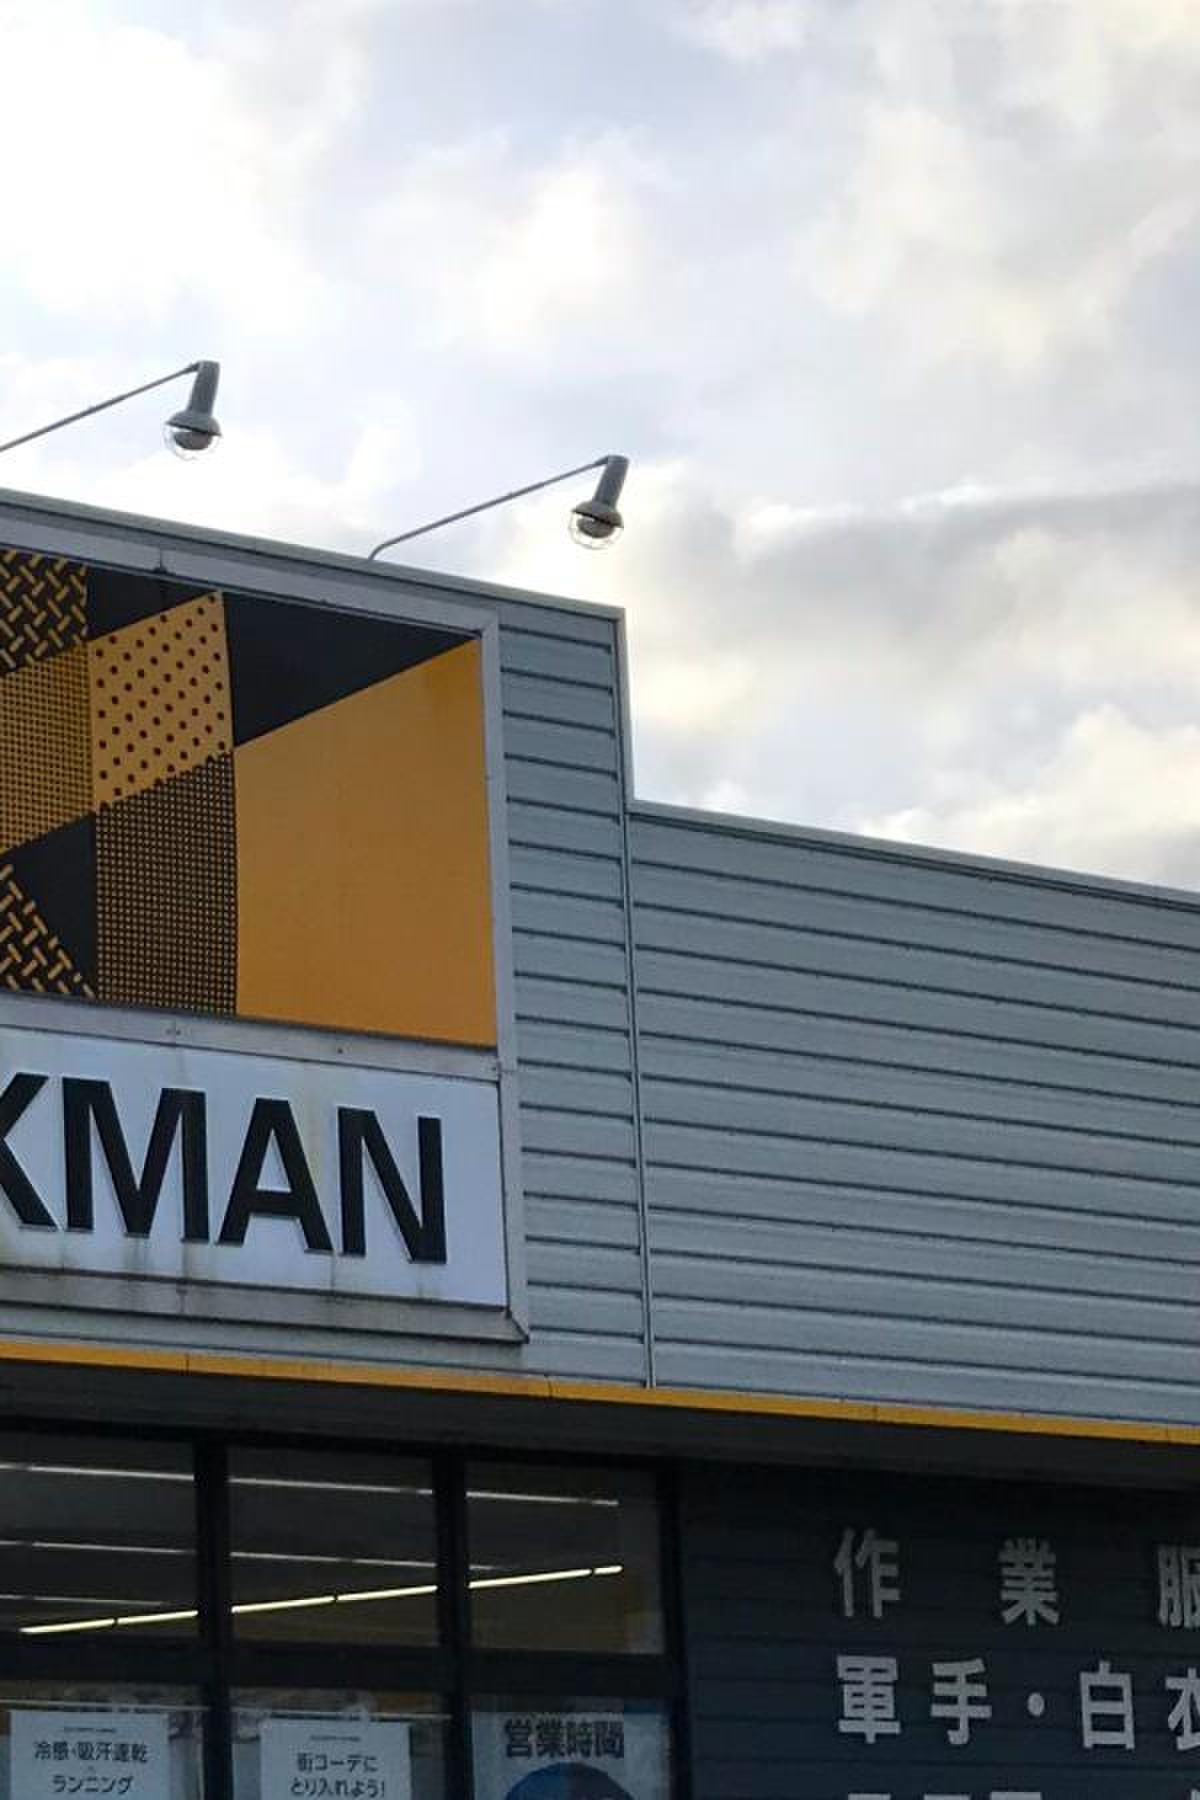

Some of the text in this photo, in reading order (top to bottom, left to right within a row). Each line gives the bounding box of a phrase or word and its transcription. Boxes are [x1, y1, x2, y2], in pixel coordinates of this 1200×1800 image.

[833, 1527, 1200, 1628] 作業服
[504, 1719, 624, 1759] 営業時間
[52, 1775, 134, 1795] ランニング
